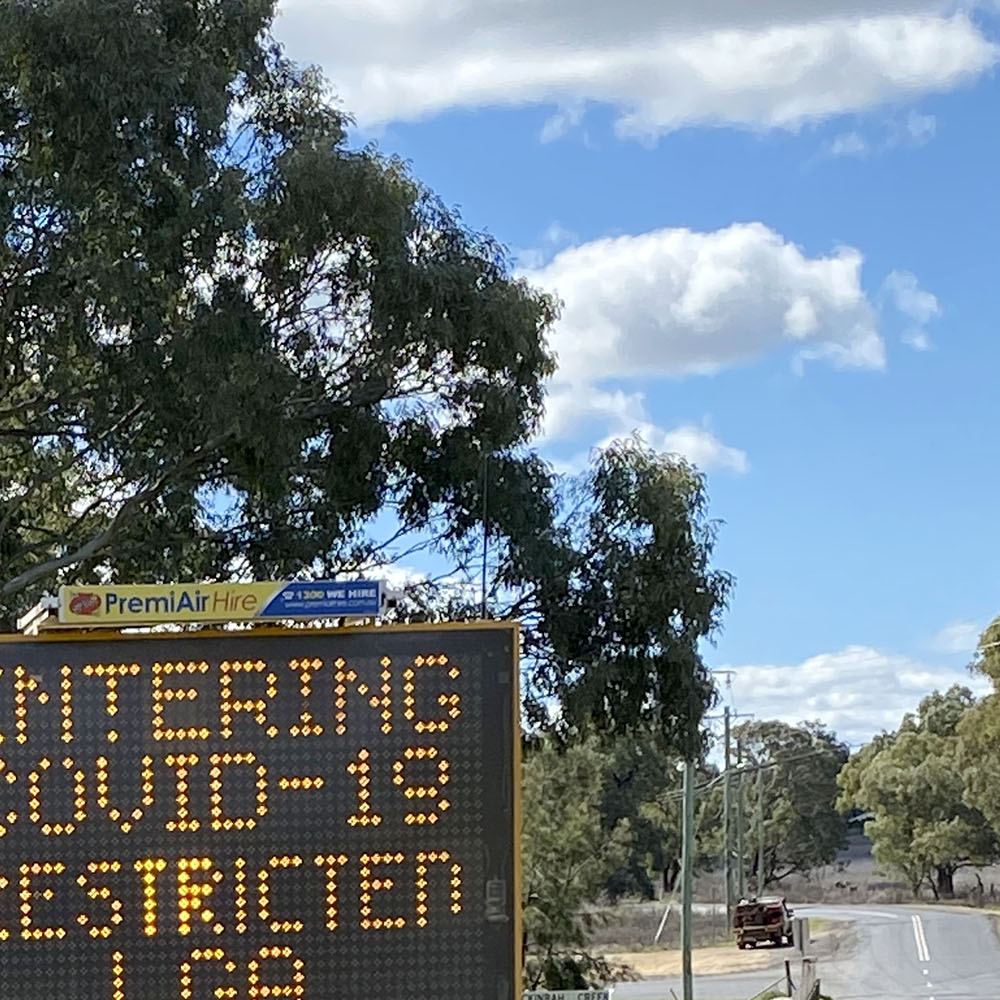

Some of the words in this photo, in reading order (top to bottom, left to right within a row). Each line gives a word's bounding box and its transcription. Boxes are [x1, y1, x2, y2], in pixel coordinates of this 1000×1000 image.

[105, 591, 210, 614] PremiAir
[212, 589, 258, 612] Hire
[326, 589, 346, 599] WE
[348, 588, 377, 599] HIRE
